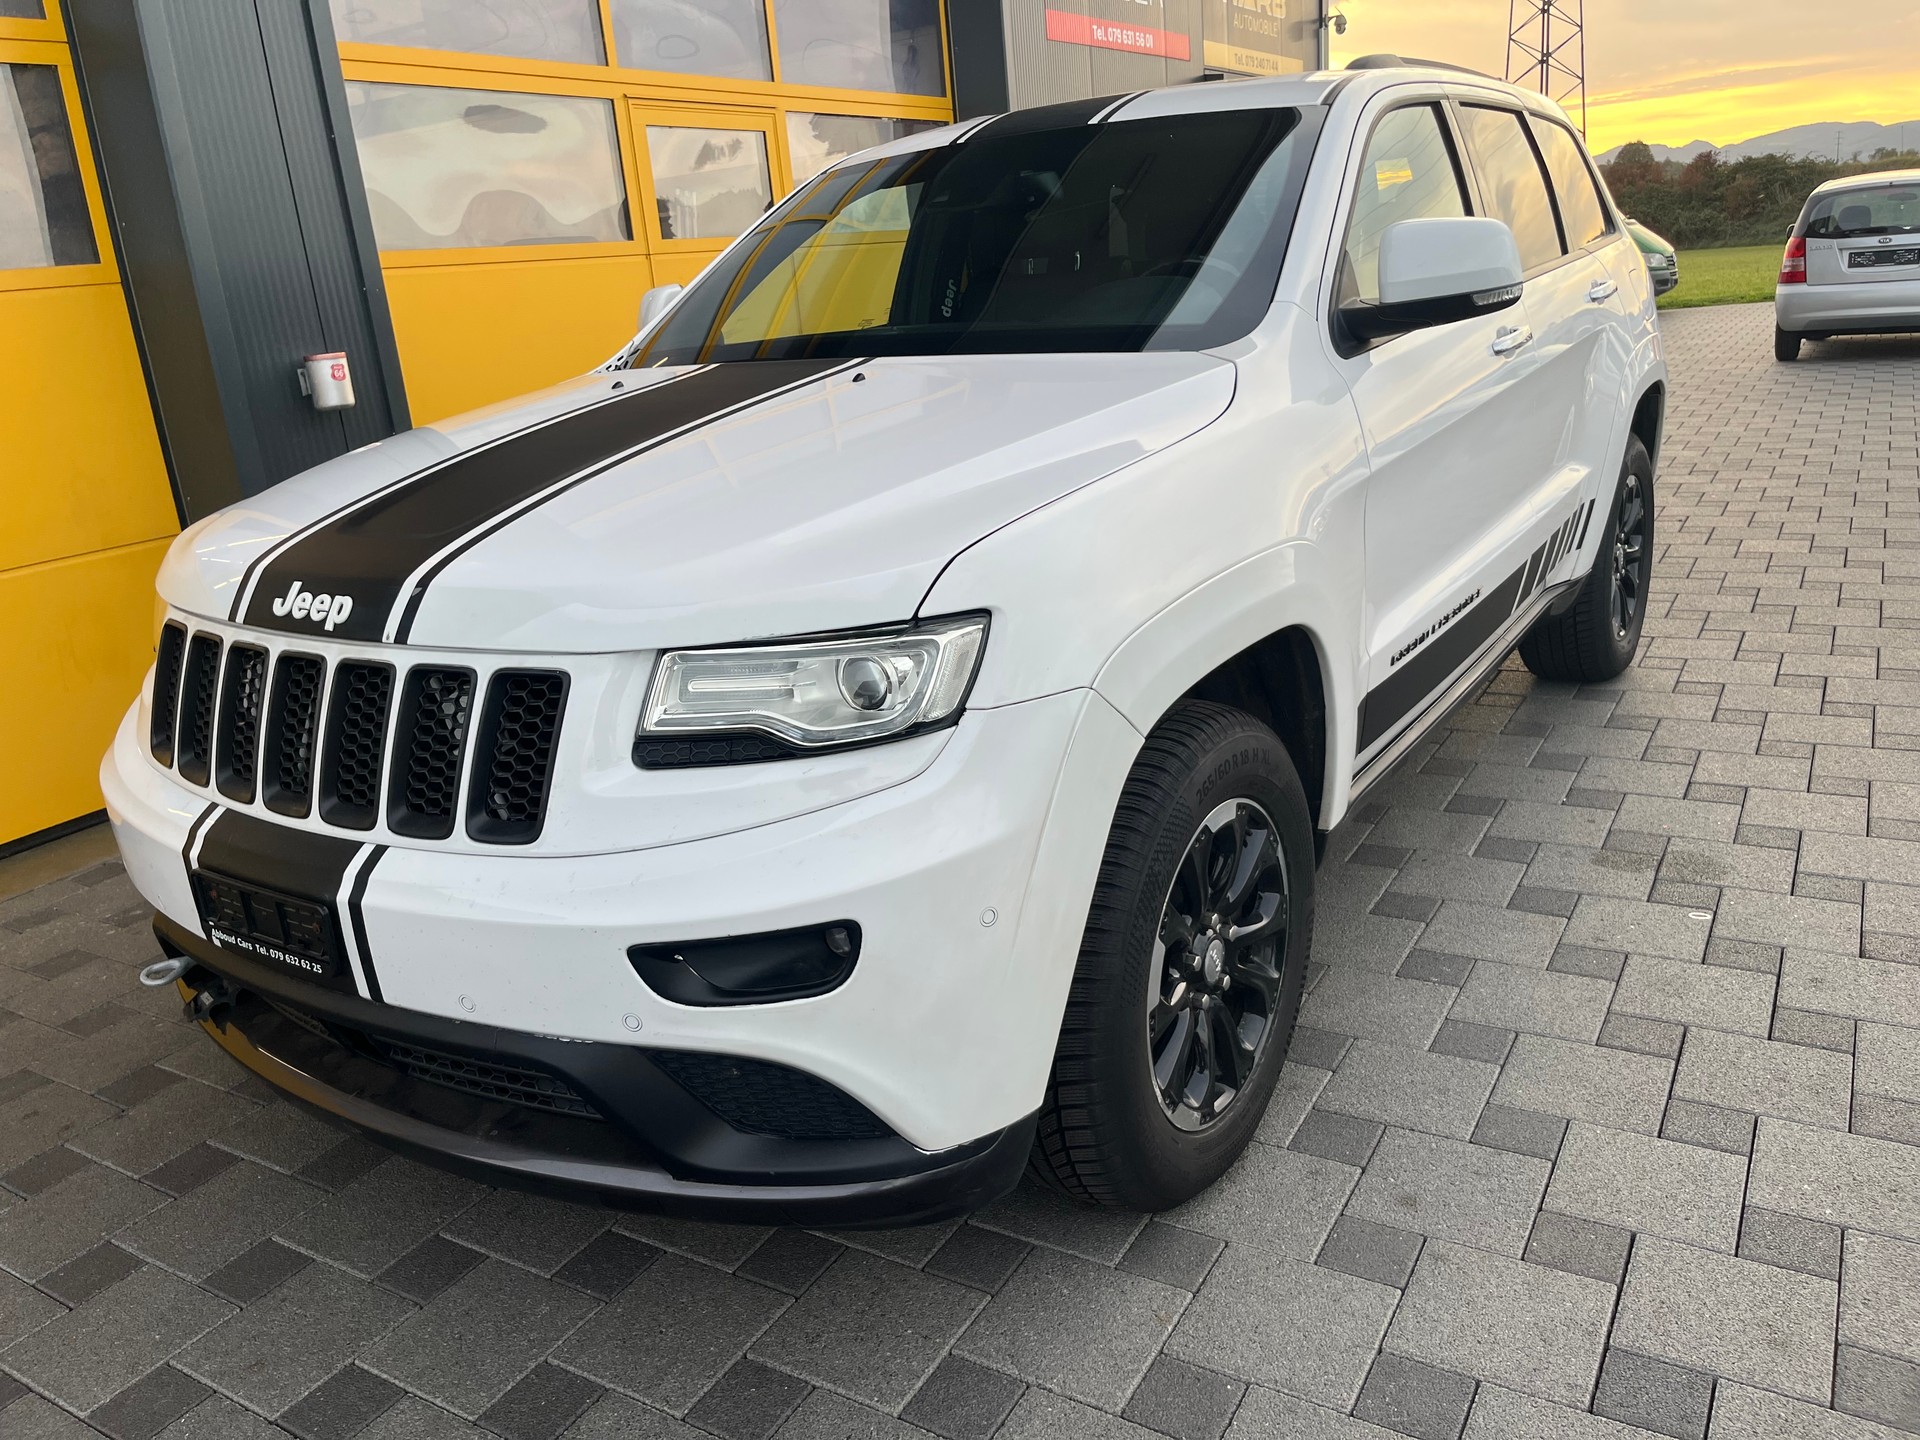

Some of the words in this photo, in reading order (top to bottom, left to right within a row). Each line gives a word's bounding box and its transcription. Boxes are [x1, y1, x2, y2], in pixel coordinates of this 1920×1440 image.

[1092, 25, 1107, 41] Tel.
[1108, 27, 1121, 44] 079
[1123, 29, 1134, 46] 631
[1136, 31, 1145, 47] 56
[1146, 33, 1154, 48] 01
[1233, 12, 1278, 37] AUTOMOBILE
[941, 279, 957, 317] Jeep
[272, 581, 353, 631] Jeep
[1196, 759, 1231, 806] 265/60
[1232, 754, 1239, 770] R
[1240, 749, 1249, 766] 18
[1253, 747, 1259, 763] H
[237, 937, 253, 950] Cars
[255, 943, 269, 956] Tel.
[270, 948, 284, 961] 079
[285, 954, 300, 967] 632
[301, 959, 311, 970] 62
[312, 963, 322, 974] 25
